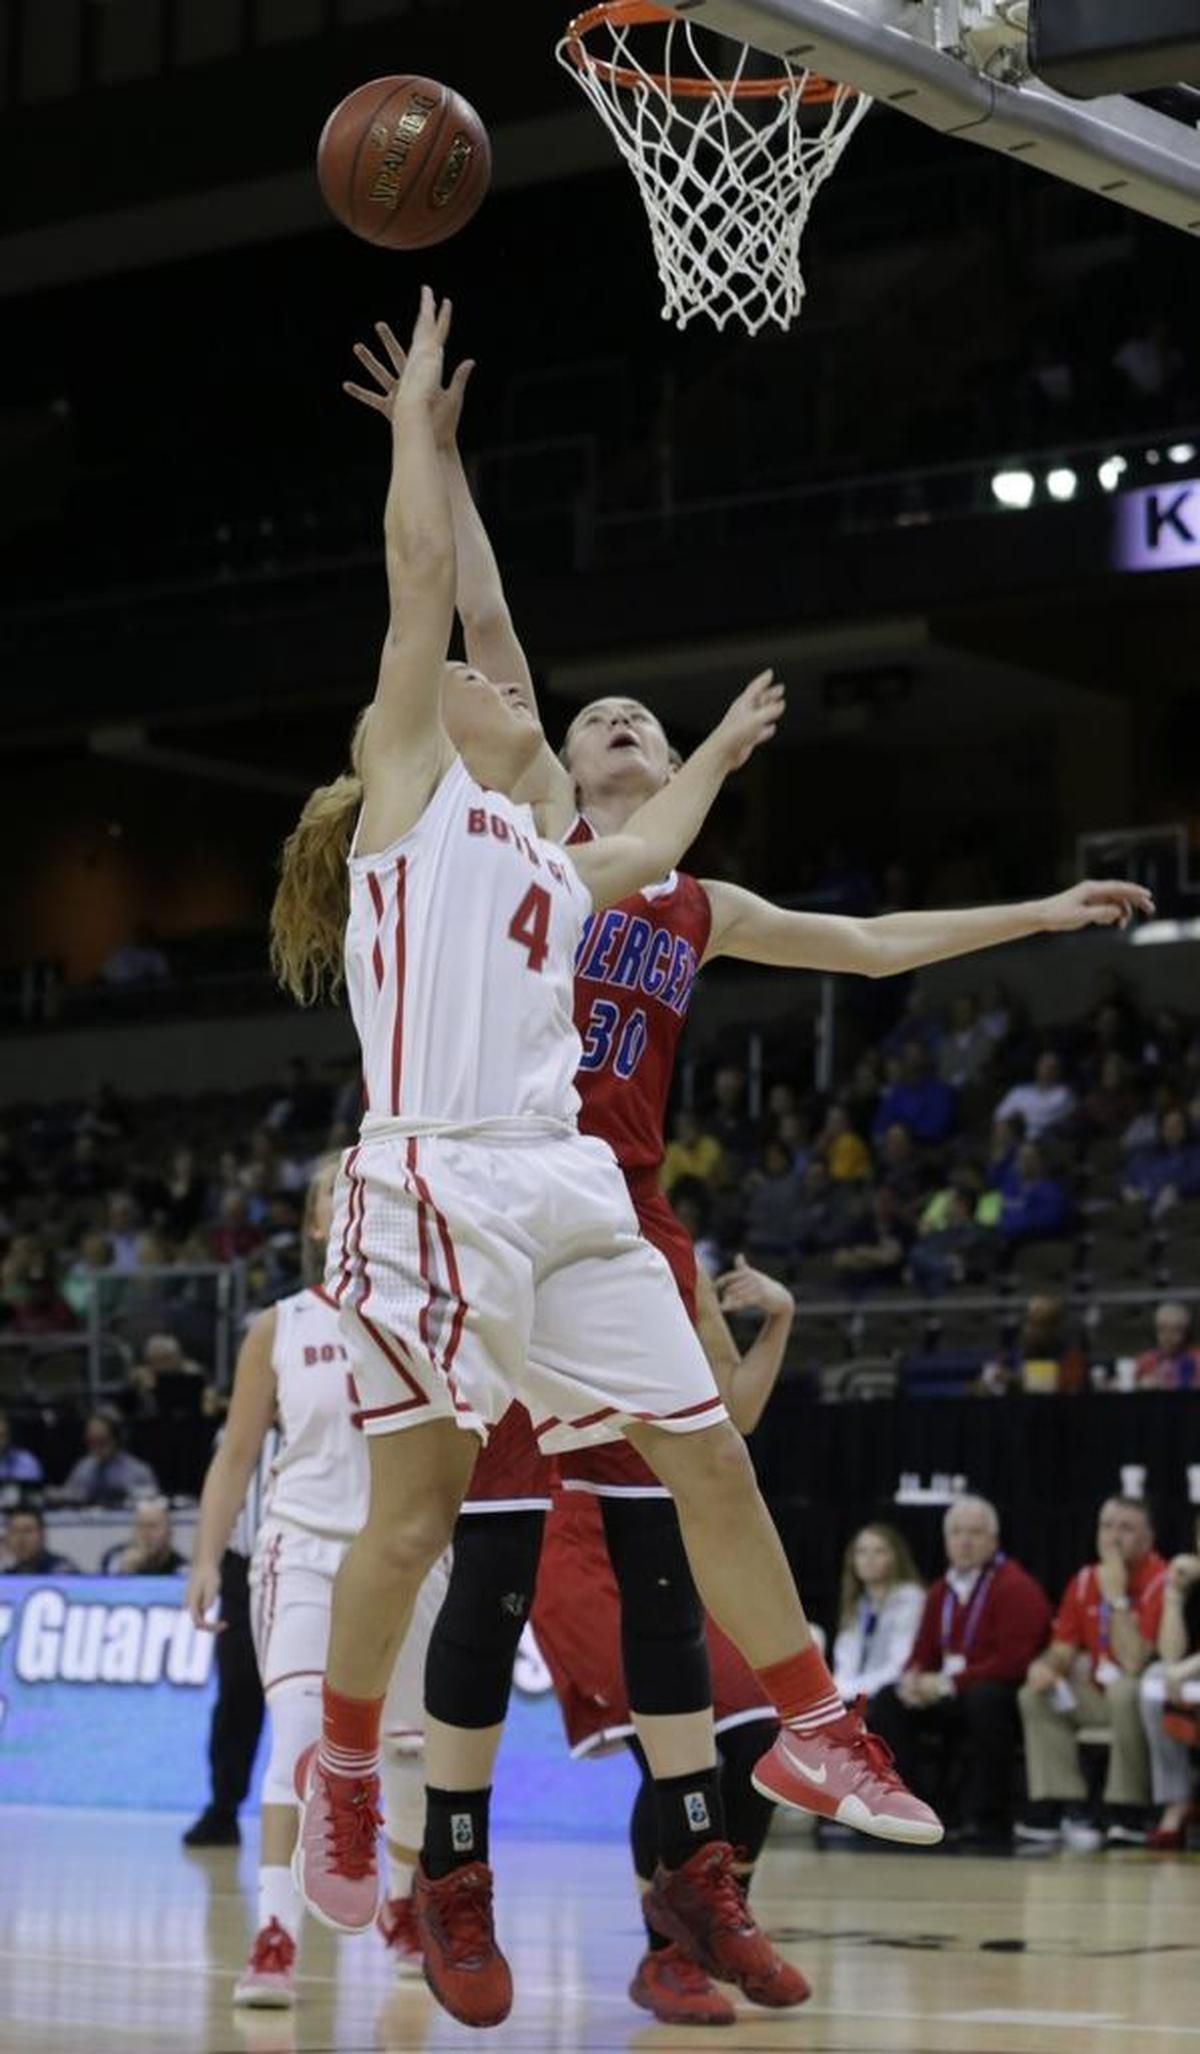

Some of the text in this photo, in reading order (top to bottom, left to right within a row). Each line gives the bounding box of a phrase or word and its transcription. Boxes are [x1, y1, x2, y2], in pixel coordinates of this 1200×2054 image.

[368, 92, 437, 210] SPALDING
[1145, 487, 1195, 549] K
[508, 881, 552, 974] 4
[573, 909, 698, 1017] ERCE
[578, 999, 647, 1081] 30
[16, 1587, 220, 1685] Guard
